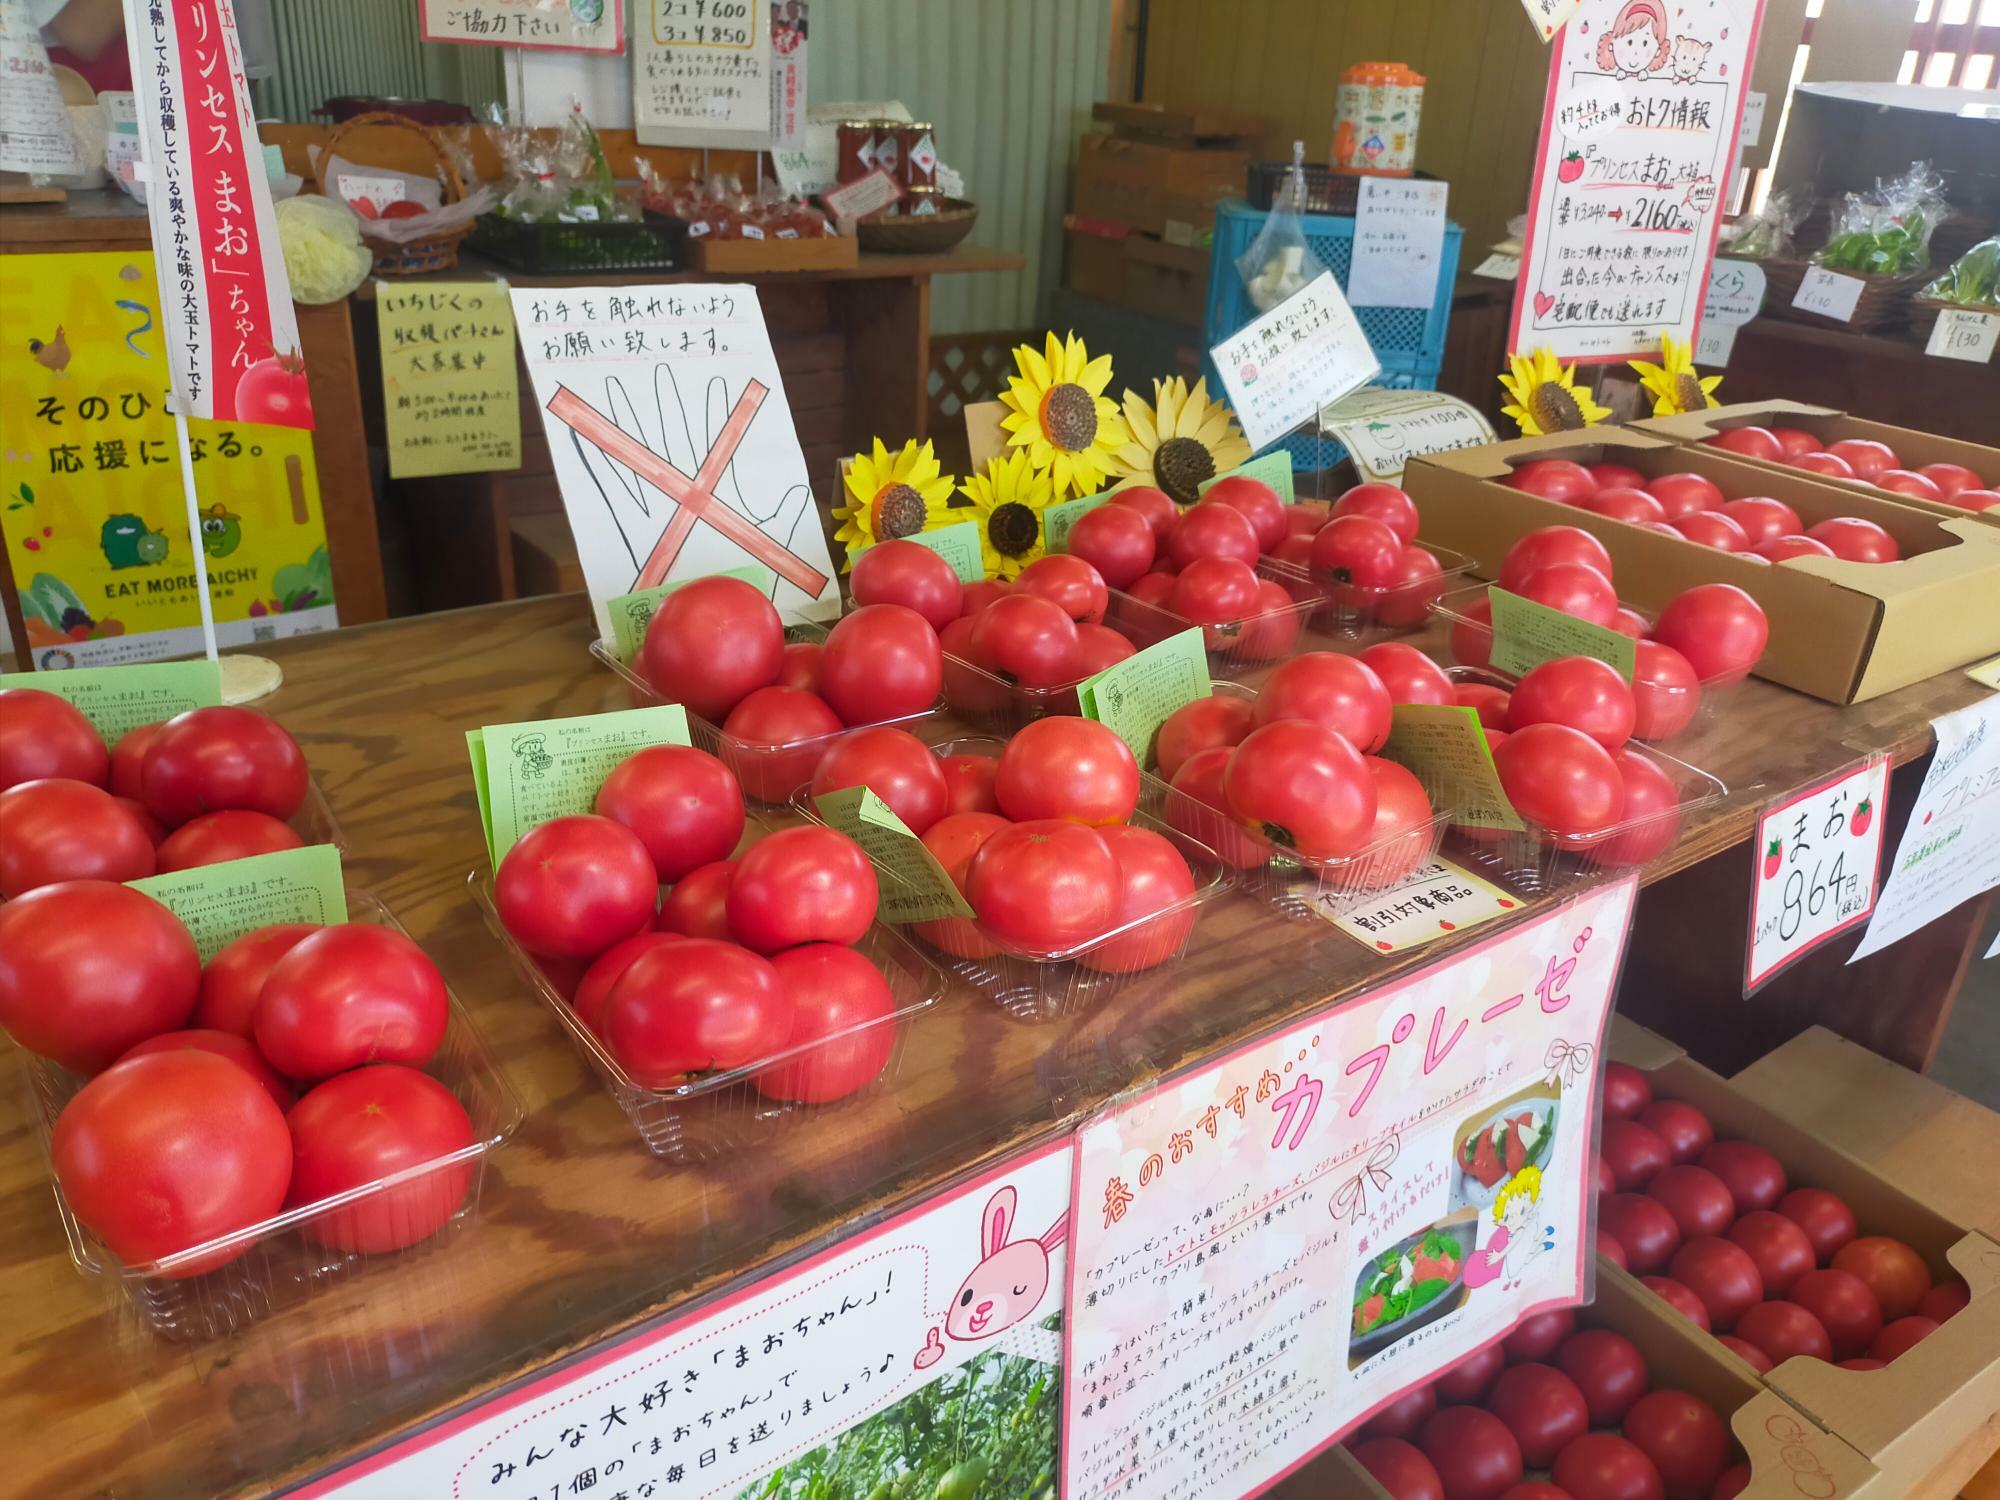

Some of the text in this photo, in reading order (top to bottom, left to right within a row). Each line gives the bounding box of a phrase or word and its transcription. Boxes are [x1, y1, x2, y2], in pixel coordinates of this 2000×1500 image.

[447, 8, 560, 36] ご協力下さい
[1626, 96, 1712, 130] おトク情報
[386, 293, 483, 313] いちじくの
[531, 296, 737, 324] お手を触れないよう
[1552, 296, 1667, 323] 宅配便でも送れます
[543, 327, 731, 359] お願い致します。
[49, 431, 264, 474] 応援になる。
[105, 580, 141, 599] EAT
[147, 574, 199, 593] MORE
[1789, 789, 1849, 864] まお
[1353, 884, 1473, 933] 割引対象商品
[1271, 924, 1593, 1151] カプレーゼ
[528, 1368, 799, 1500] 1個の「まおちゃん」で
